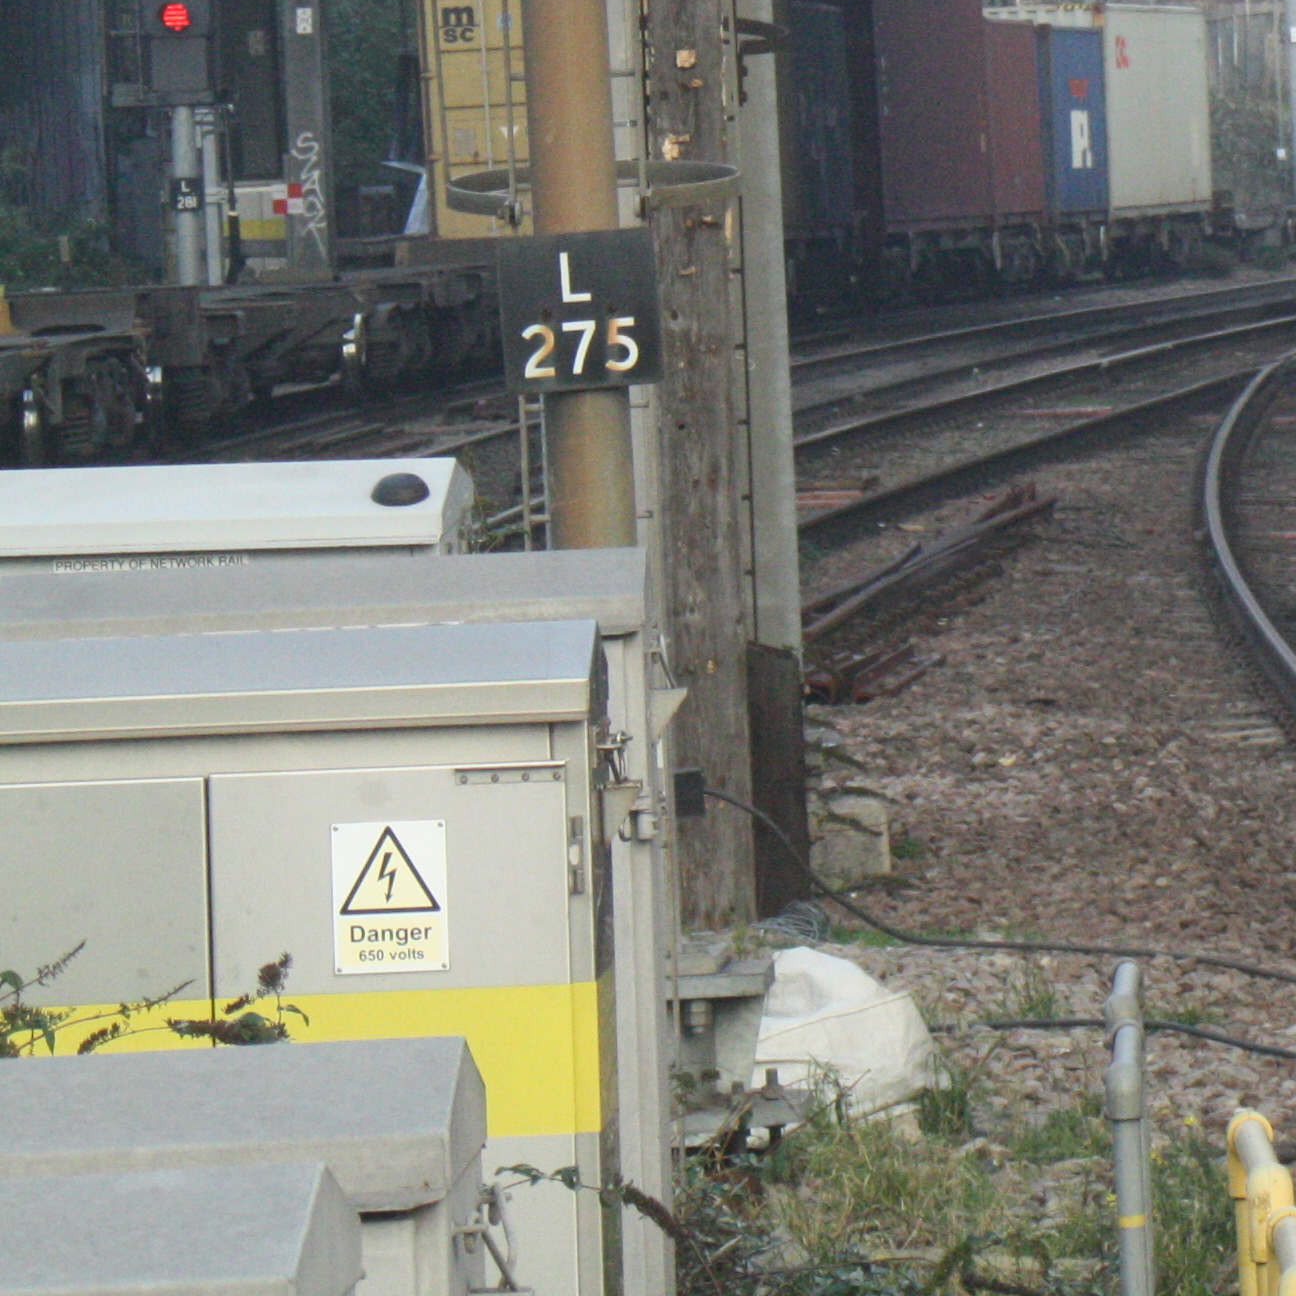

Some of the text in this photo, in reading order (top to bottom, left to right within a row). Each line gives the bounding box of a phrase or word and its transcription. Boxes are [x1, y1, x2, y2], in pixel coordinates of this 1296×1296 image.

[181, 180, 191, 192] L
[177, 195, 197, 209] 281
[560, 251, 592, 303] L
[521, 316, 639, 379] 275
[55, 553, 246, 572] PROPERTY OF NETWORK RAIL
[350, 925, 432, 946] Danger
[359, 948, 425, 962] 650 volts
